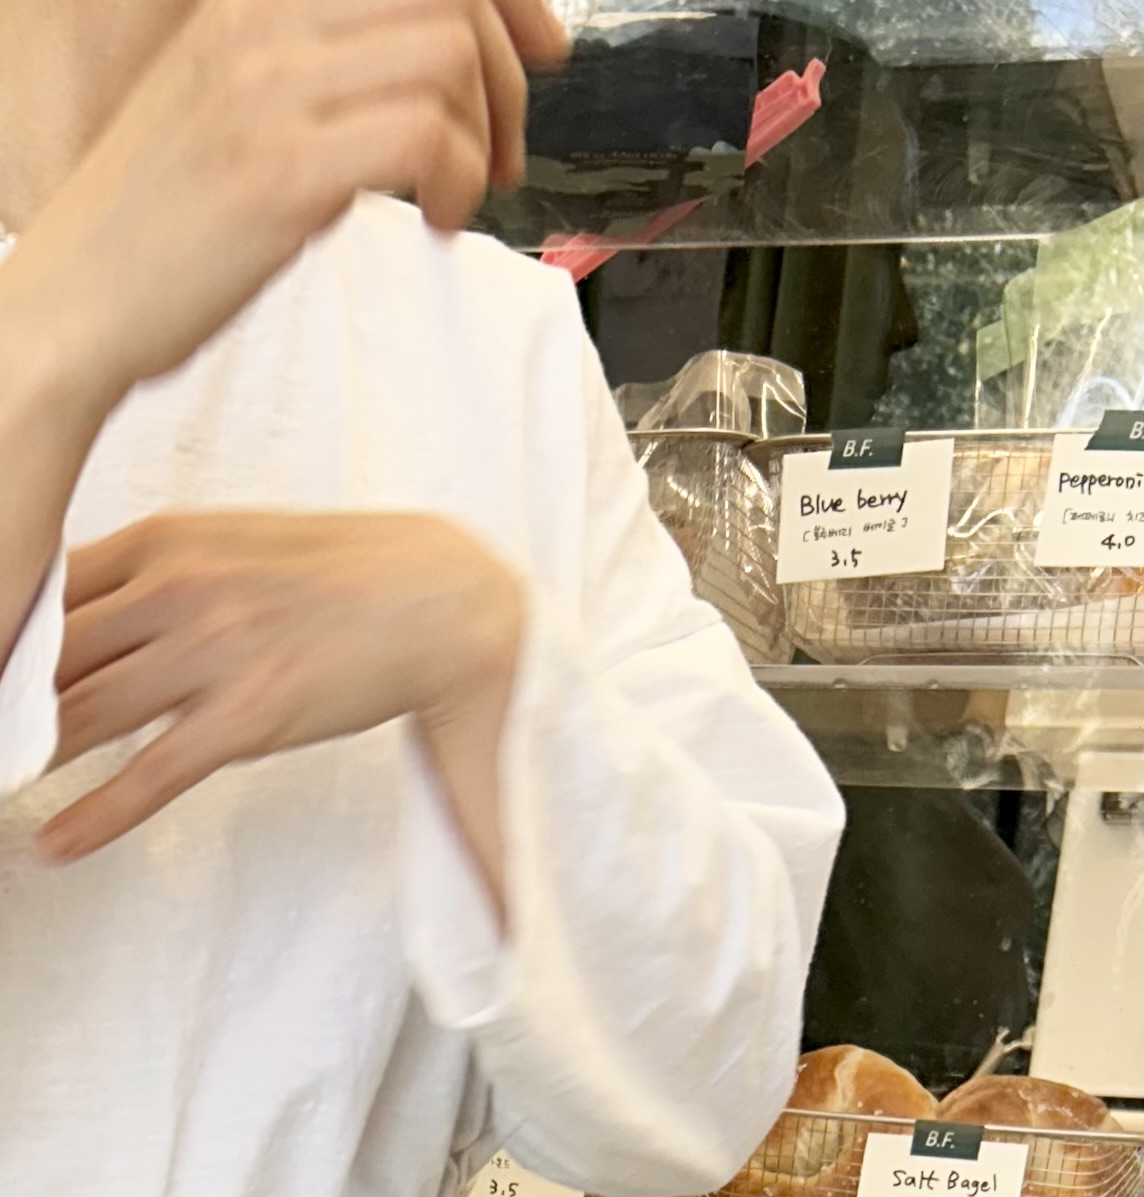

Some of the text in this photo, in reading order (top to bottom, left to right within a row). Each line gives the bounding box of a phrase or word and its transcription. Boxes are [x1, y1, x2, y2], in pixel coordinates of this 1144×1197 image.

[842, 438, 874, 458] B.F.
[800, 489, 908, 517] Blue berry
[1100, 533, 1136, 550] 4.0
[830, 548, 862, 568] 3.5
[925, 1130, 956, 1149] B.F.
[489, 1178, 520, 1197] 3.5
[892, 1169, 998, 1197] Salt Bagel
